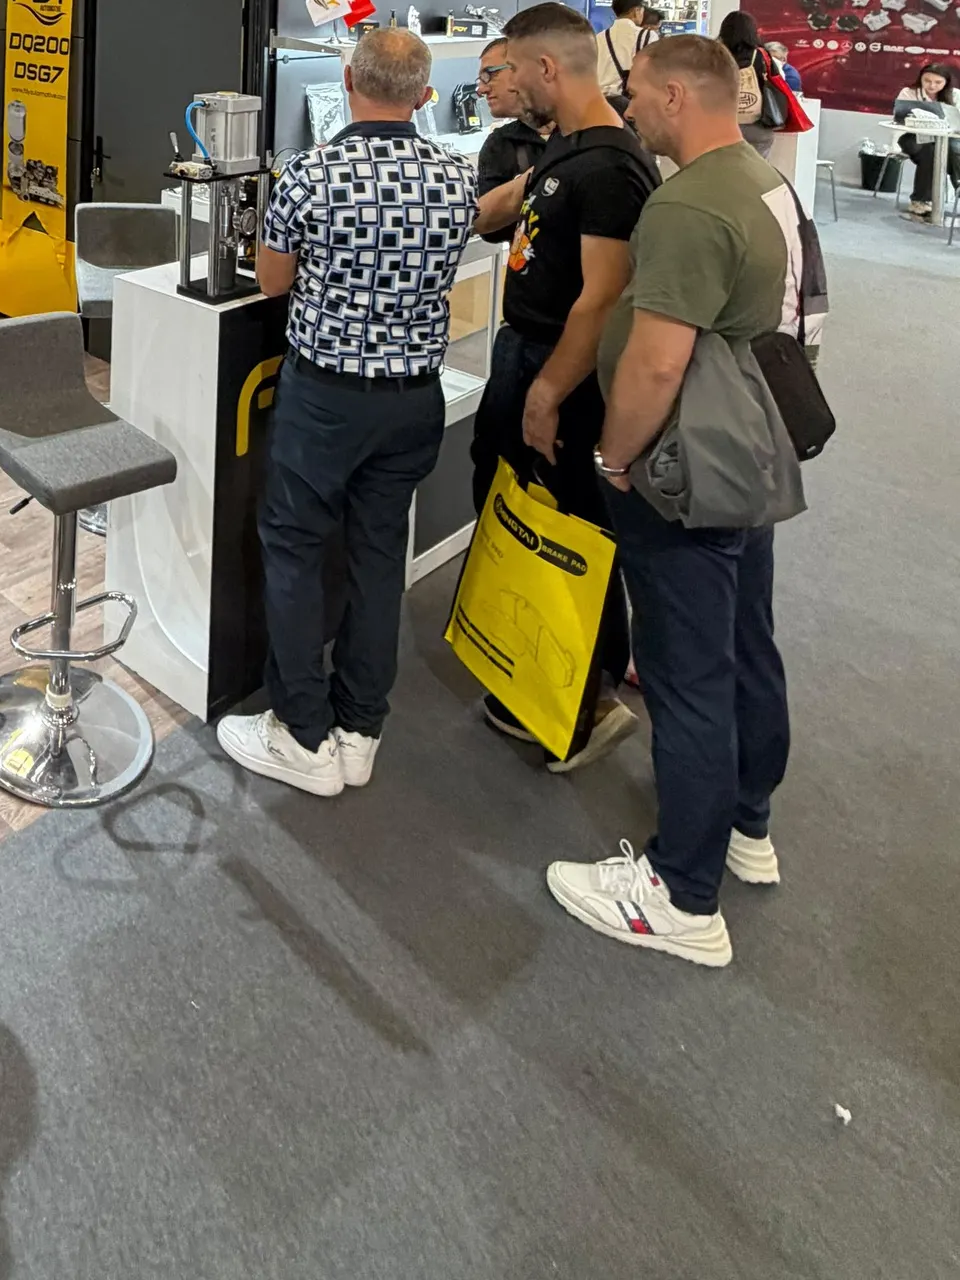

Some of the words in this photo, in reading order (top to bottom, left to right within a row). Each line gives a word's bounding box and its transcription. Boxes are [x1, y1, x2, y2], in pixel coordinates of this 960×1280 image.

[9, 32, 70, 56] DQ200
[14, 61, 64, 83] DSG7
[541, 544, 568, 562] BRAKE
[570, 558, 587, 572] PAD
